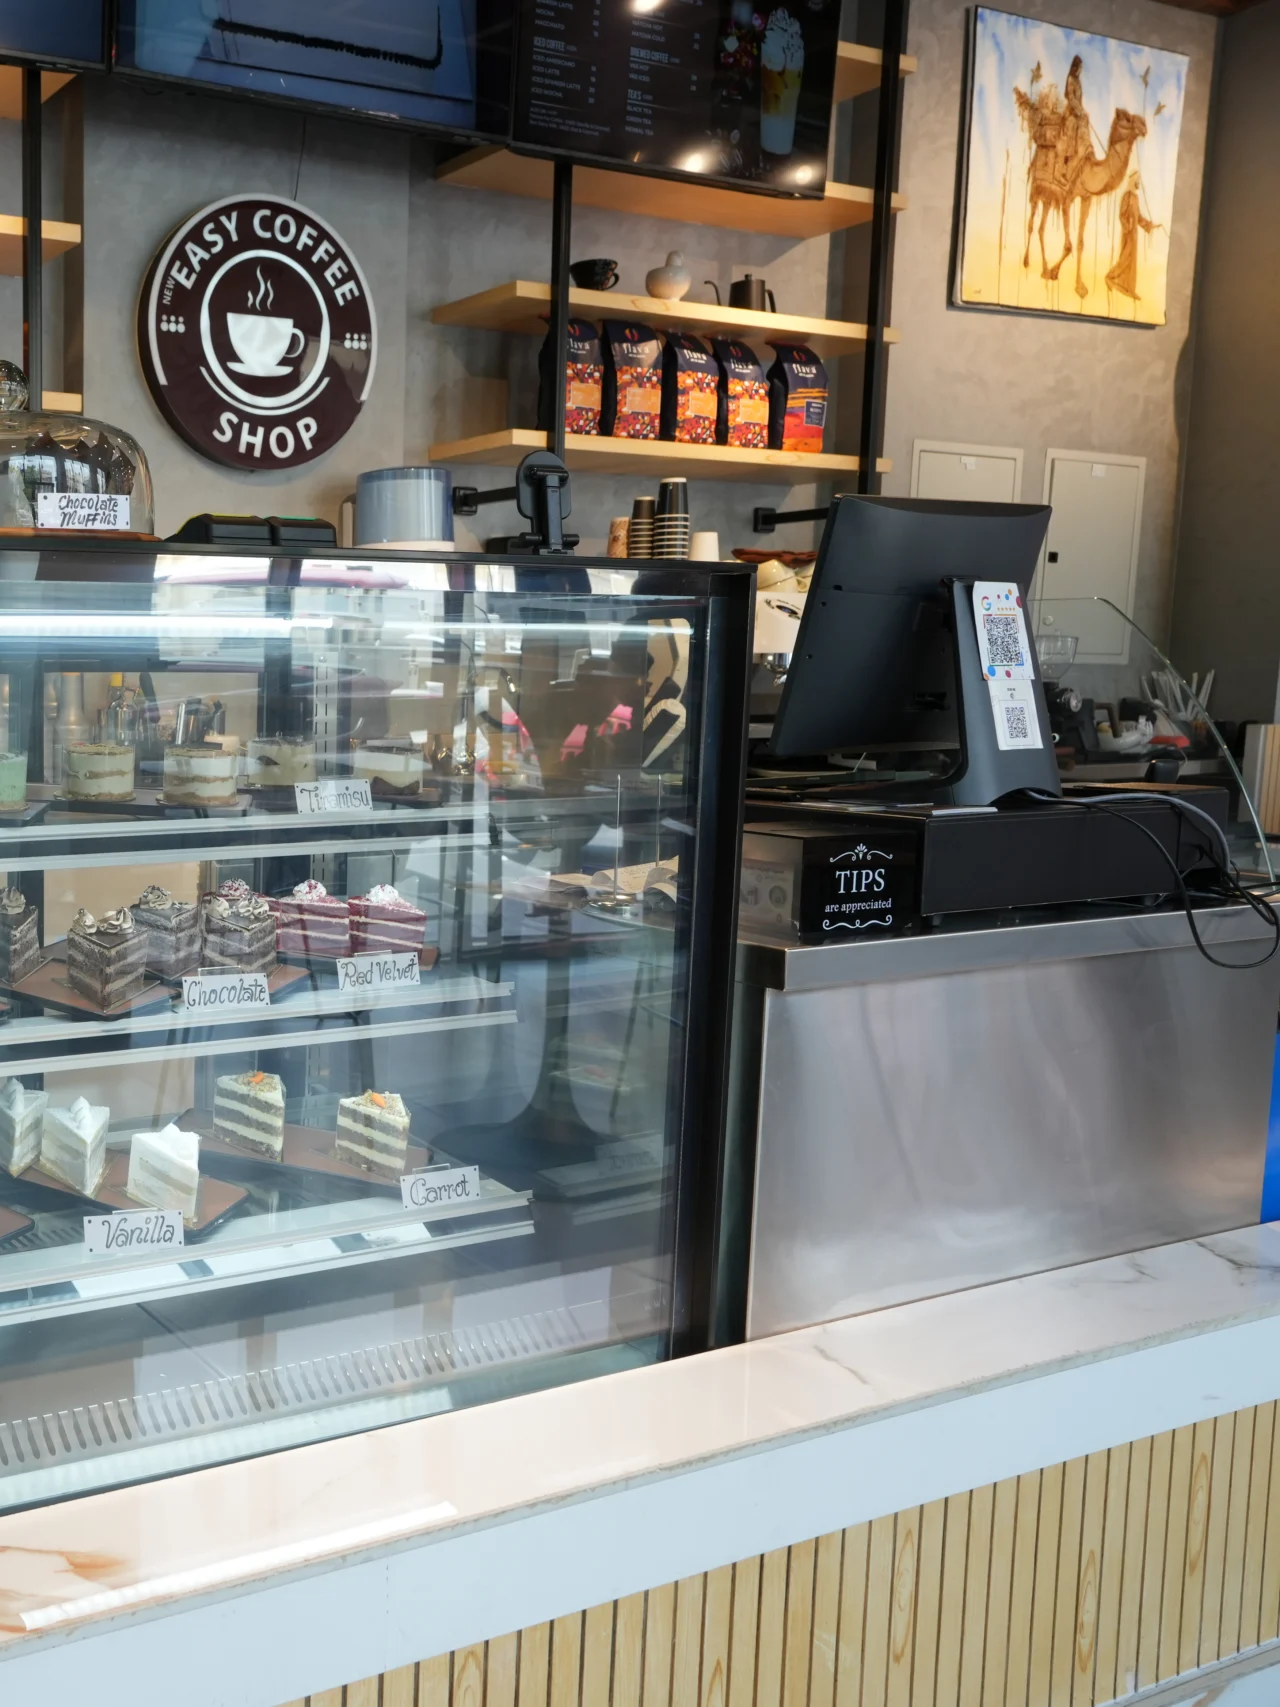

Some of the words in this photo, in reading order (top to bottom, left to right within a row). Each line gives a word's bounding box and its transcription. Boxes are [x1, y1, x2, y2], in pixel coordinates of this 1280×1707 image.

[170, 211, 239, 290] EASY
[253, 209, 360, 307] COFFEE
[163, 277, 176, 305] NEW
[792, 363, 817, 374] flava
[212, 411, 318, 459] SHOP
[58, 495, 119, 512] Chocolate
[300, 786, 370, 813] Tiramisu
[835, 868, 886, 894] TIPS
[825, 903, 840, 913] are
[841, 898, 892, 914] appreciated
[340, 961, 372, 988] Red
[375, 958, 417, 983] Velvet
[186, 978, 267, 1007] Chocolate
[409, 1173, 471, 1206] Carrot
[101, 1215, 175, 1249] Vanilla
